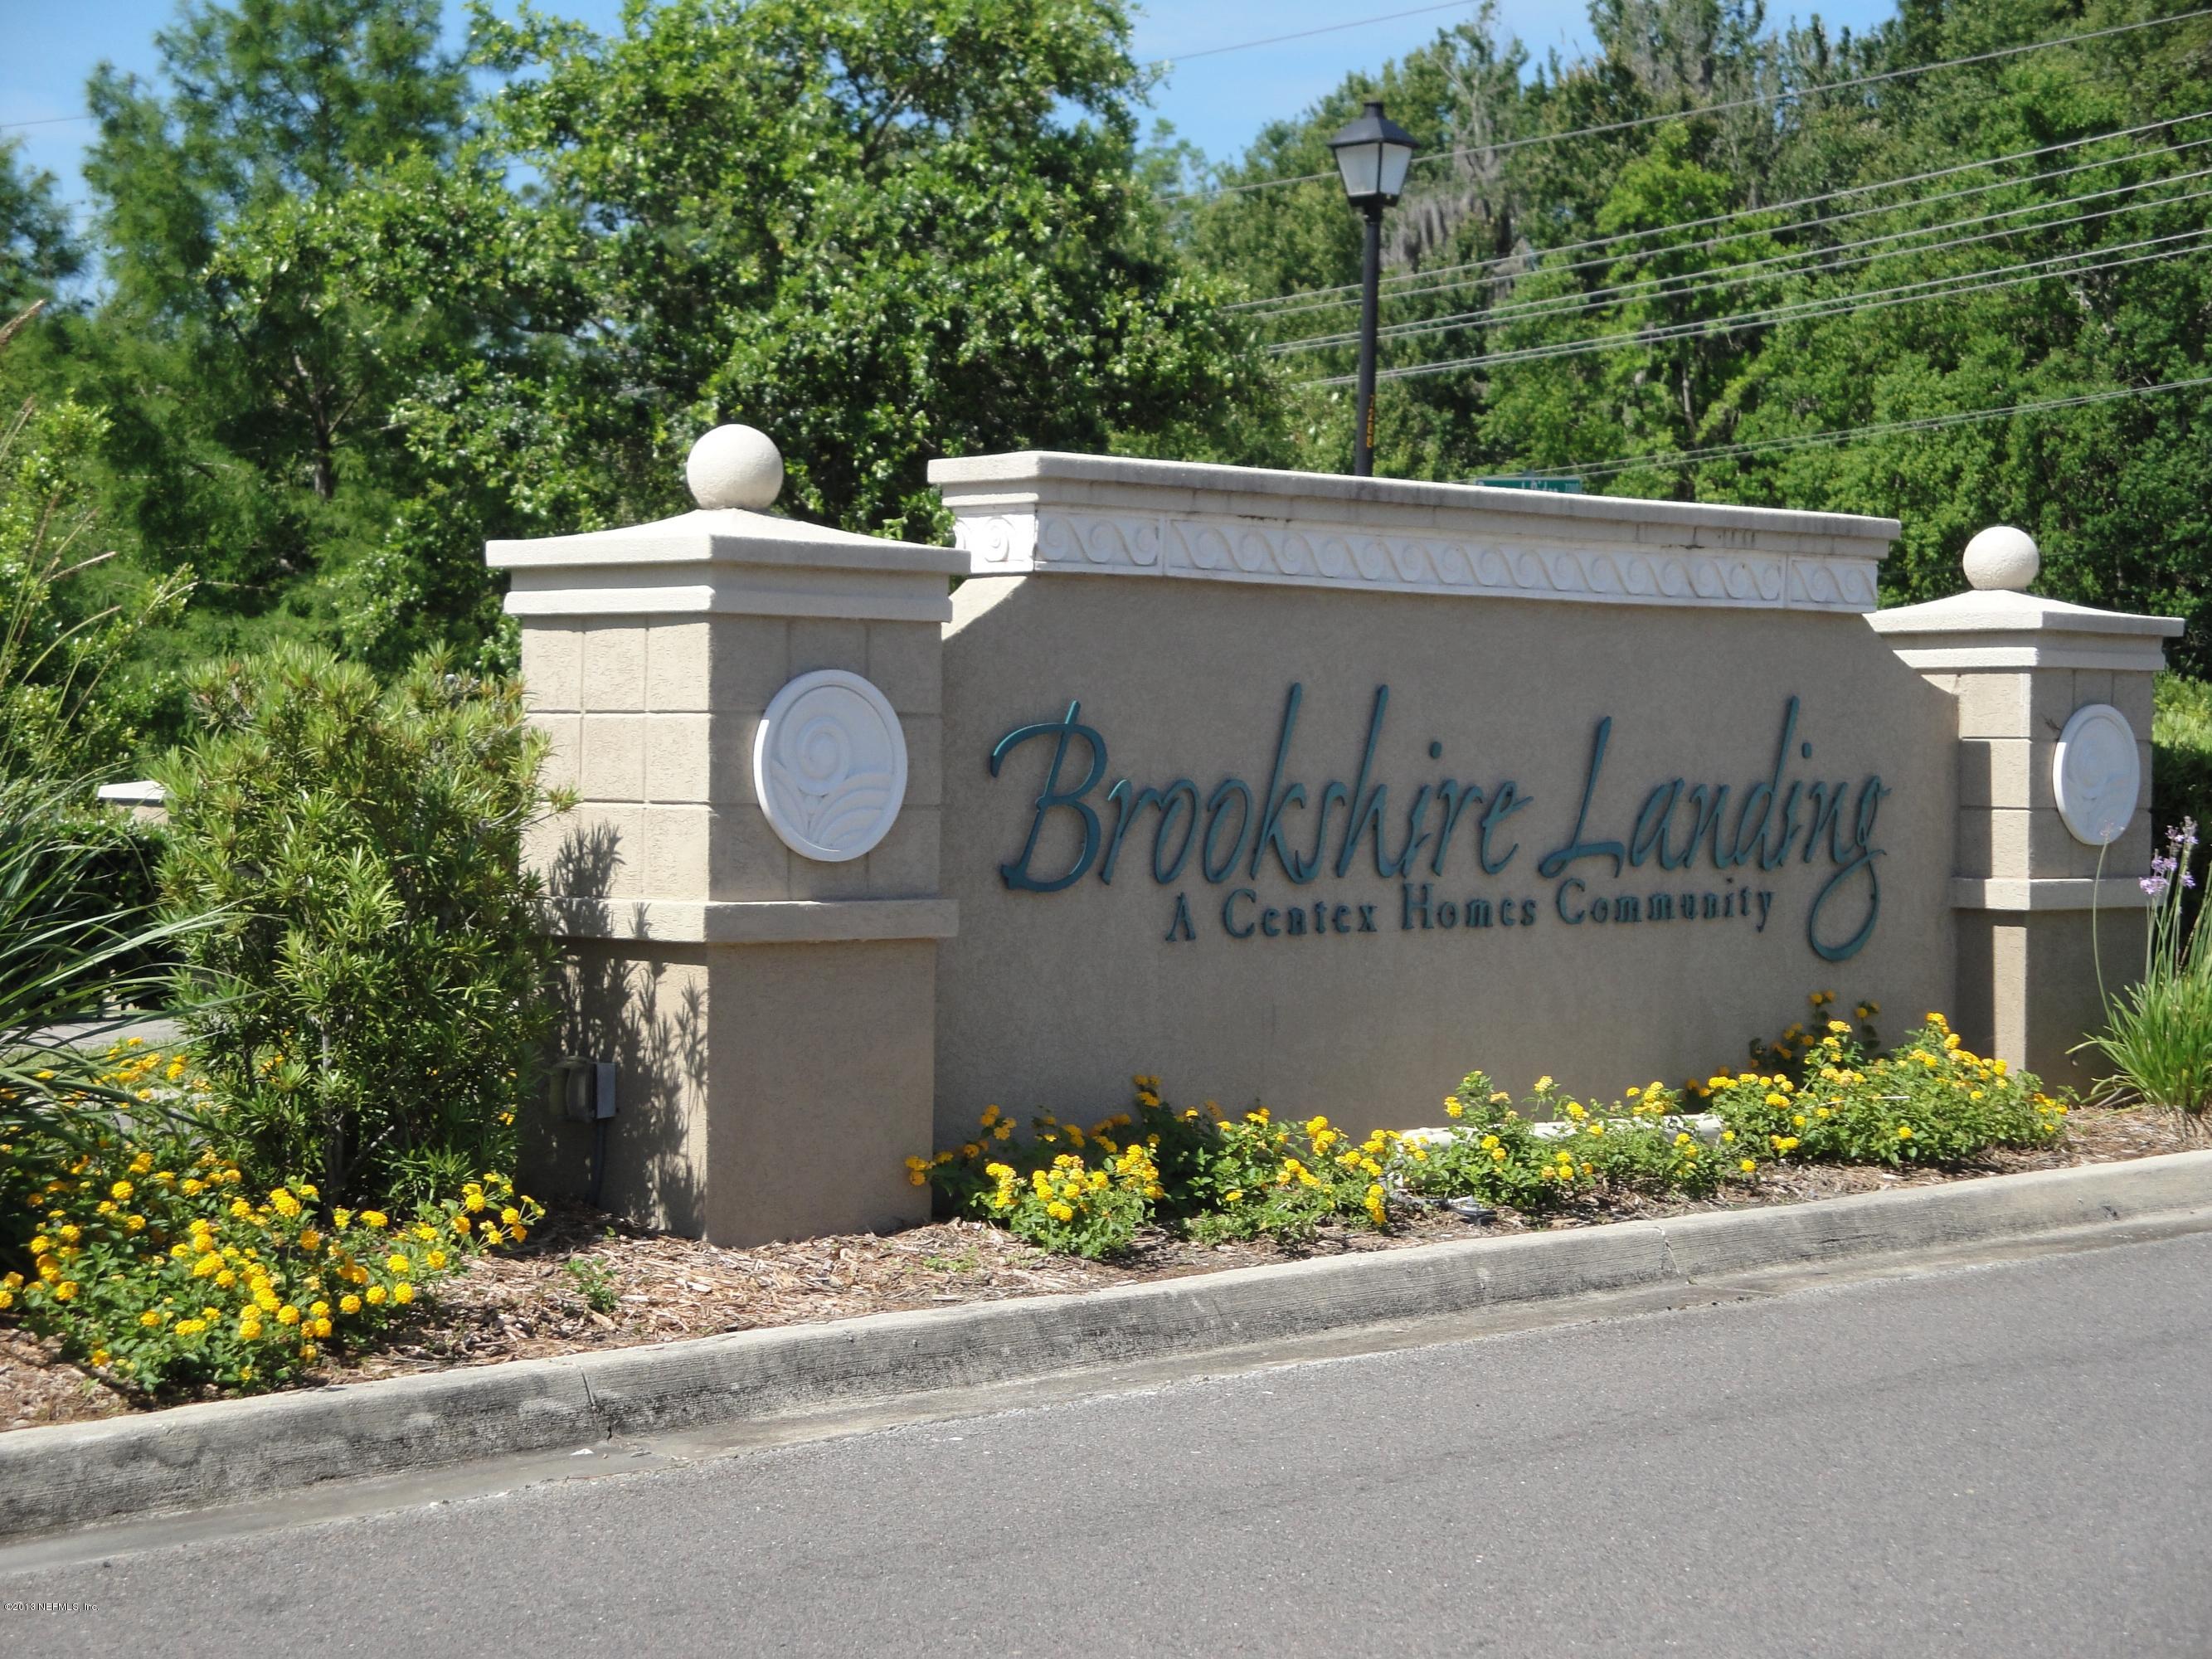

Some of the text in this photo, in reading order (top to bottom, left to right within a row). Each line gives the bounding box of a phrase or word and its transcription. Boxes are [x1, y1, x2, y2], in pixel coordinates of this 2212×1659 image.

[989, 682, 1892, 961] Brookshire Landing
[1164, 876, 1774, 942] A Centex Homes Community
